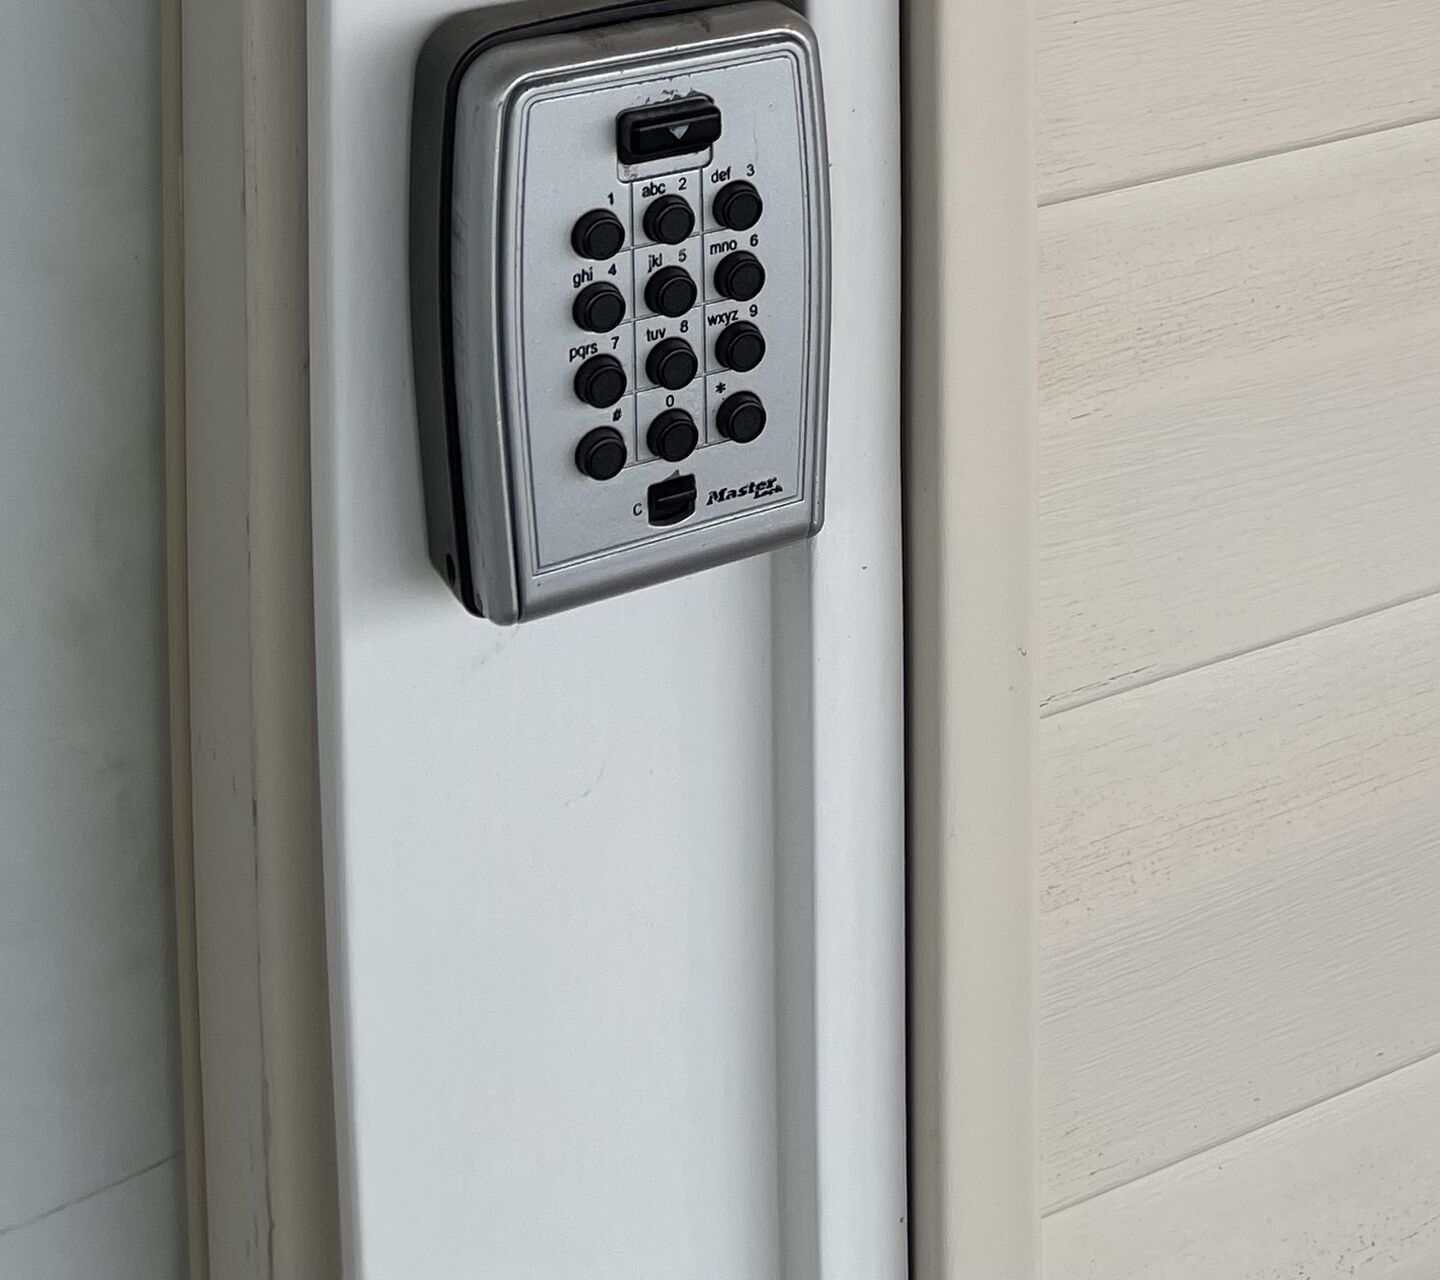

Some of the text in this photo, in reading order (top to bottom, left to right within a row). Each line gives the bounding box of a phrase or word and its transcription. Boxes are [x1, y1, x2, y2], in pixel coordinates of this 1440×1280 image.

[711, 164, 756, 184] def 3
[641, 177, 688, 198] abc 2
[607, 193, 614, 206] 1
[709, 233, 759, 255] mno 6
[647, 248, 687, 273] jkl 5
[573, 263, 617, 288] ghi 4
[707, 304, 758, 327] wxyz 9
[646, 320, 689, 342] tuv 8
[569, 336, 620, 362] pqrs 7
[705, 476, 777, 506] Master
[753, 484, 784, 499] Lock
[632, 502, 643, 516] C
